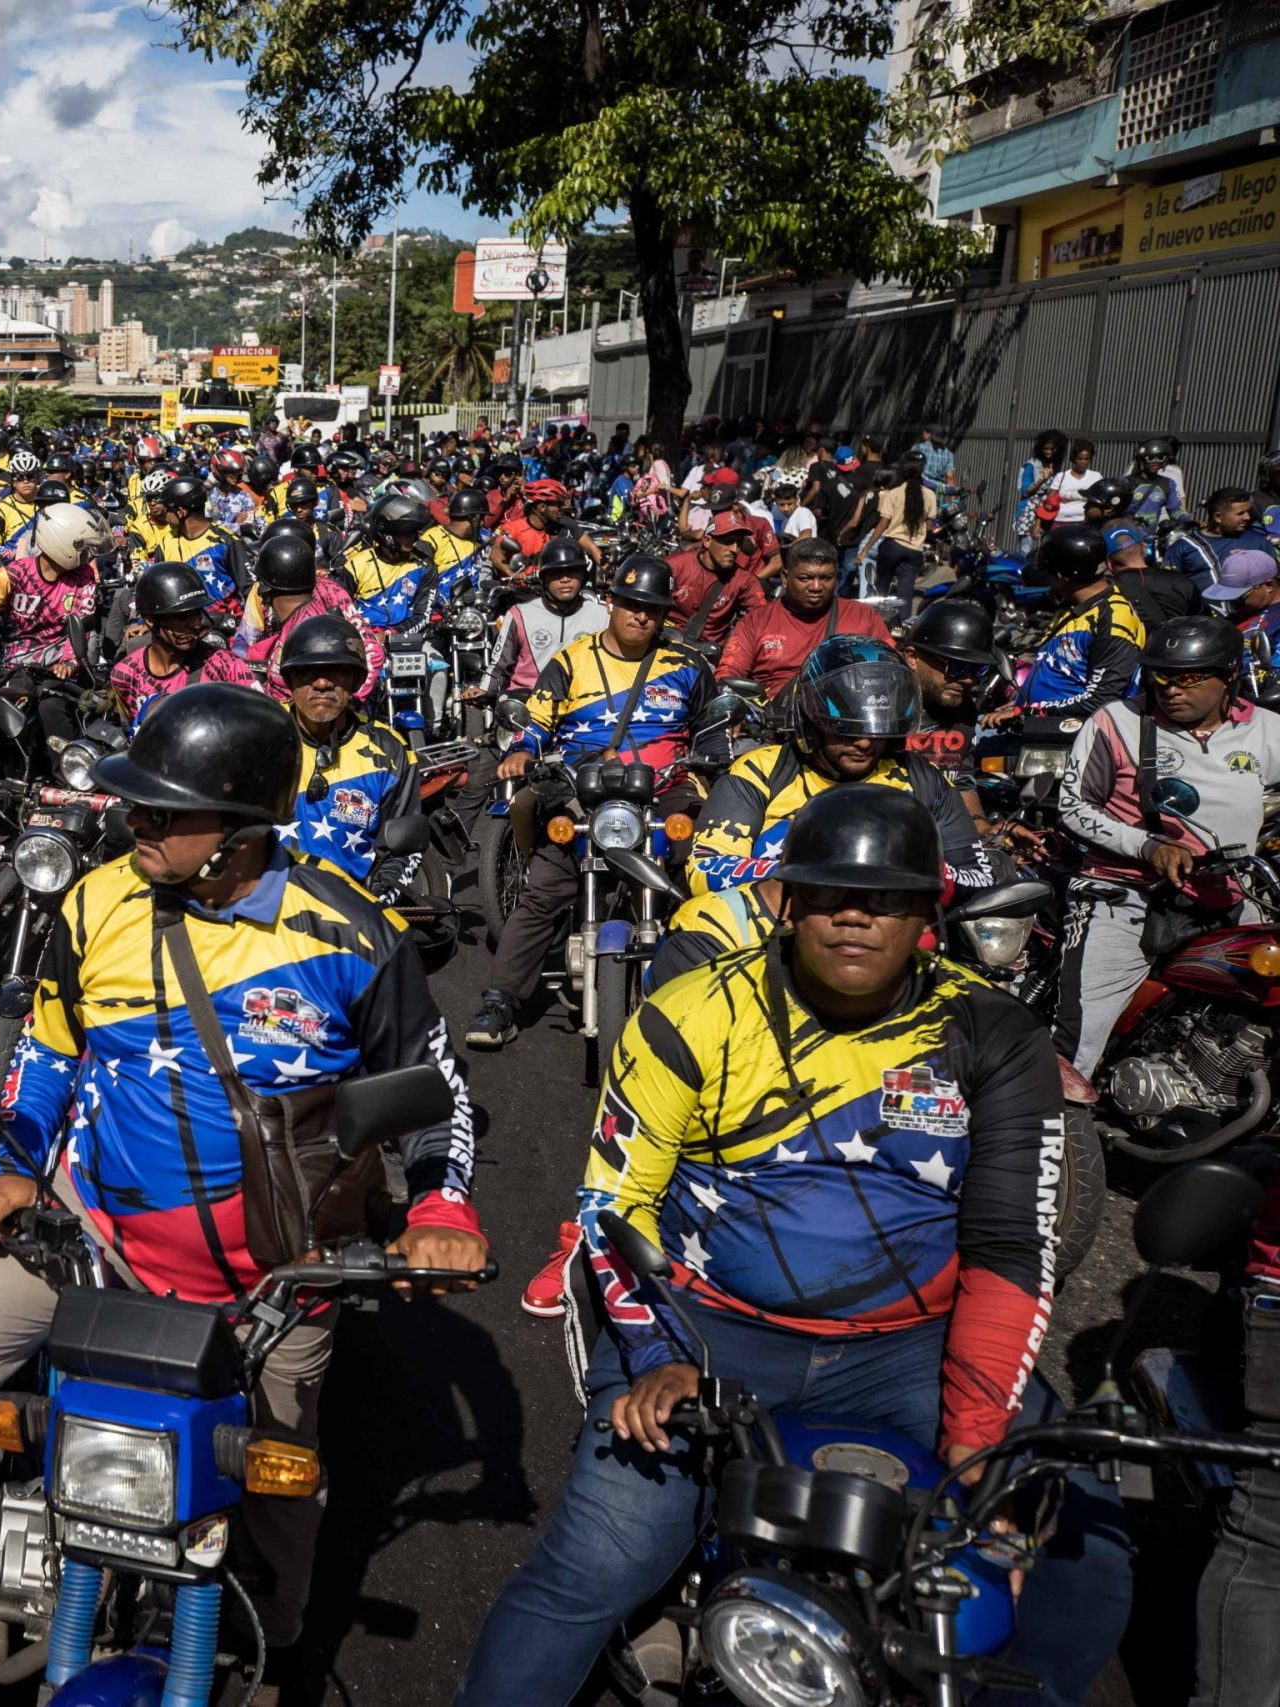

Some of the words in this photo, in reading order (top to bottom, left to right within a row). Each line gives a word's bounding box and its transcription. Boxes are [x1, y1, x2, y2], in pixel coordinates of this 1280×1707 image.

[1143, 202, 1152, 220] a
[1156, 192, 1169, 217] la
[1231, 166, 1277, 205] llegó
[1139, 227, 1154, 253] el
[1155, 222, 1204, 250] nuevo
[1208, 207, 1276, 239] veciiino
[220, 347, 273, 356] ATENCION
[13, 593, 41, 616] 07
[179, 589, 206, 601] BERA
